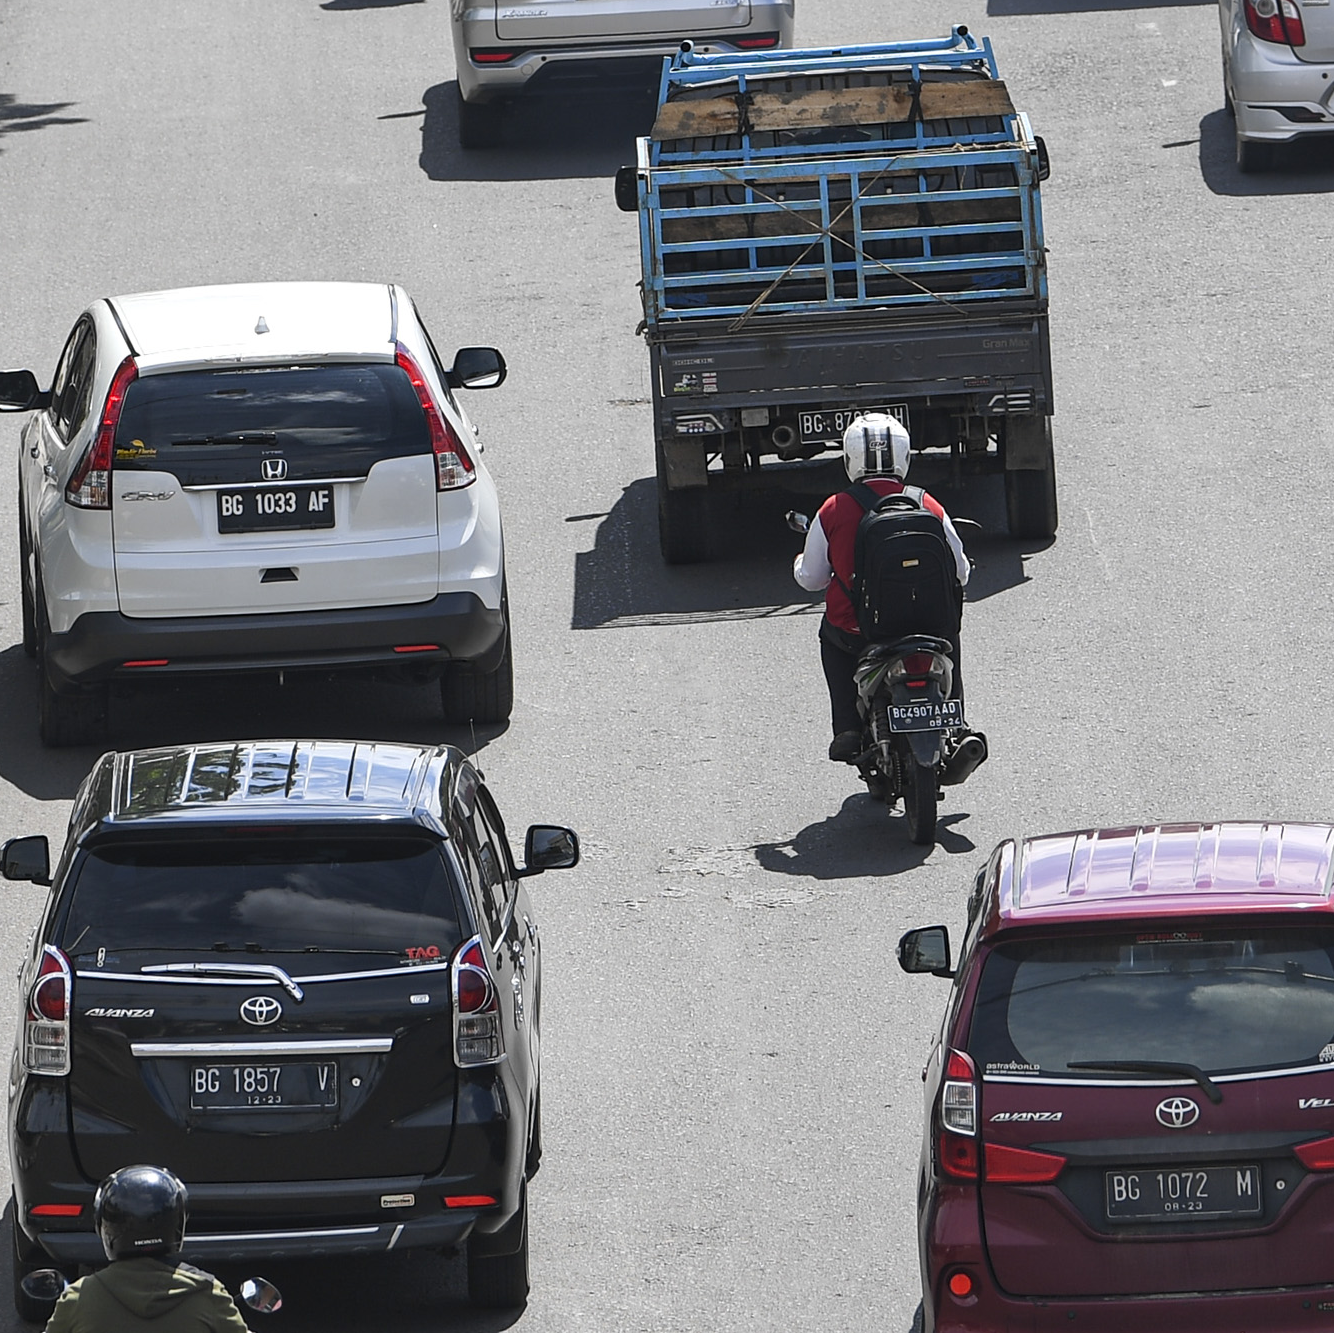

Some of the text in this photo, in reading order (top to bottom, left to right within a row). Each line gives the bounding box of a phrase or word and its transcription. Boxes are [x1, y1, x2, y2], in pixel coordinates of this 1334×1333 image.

[982, 337, 1031, 349] Gran Max
[802, 414, 823, 435] BG
[835, 409, 871, 431] 87
[221, 490, 329, 516] BG 1033 AF
[405, 945, 441, 960] TAG
[84, 1007, 155, 1018] AVANZA
[194, 1066, 329, 1093] BG 1857 V
[989, 1112, 1063, 1122] AVANZA
[1113, 1169, 1252, 1202] BG 1072 M
